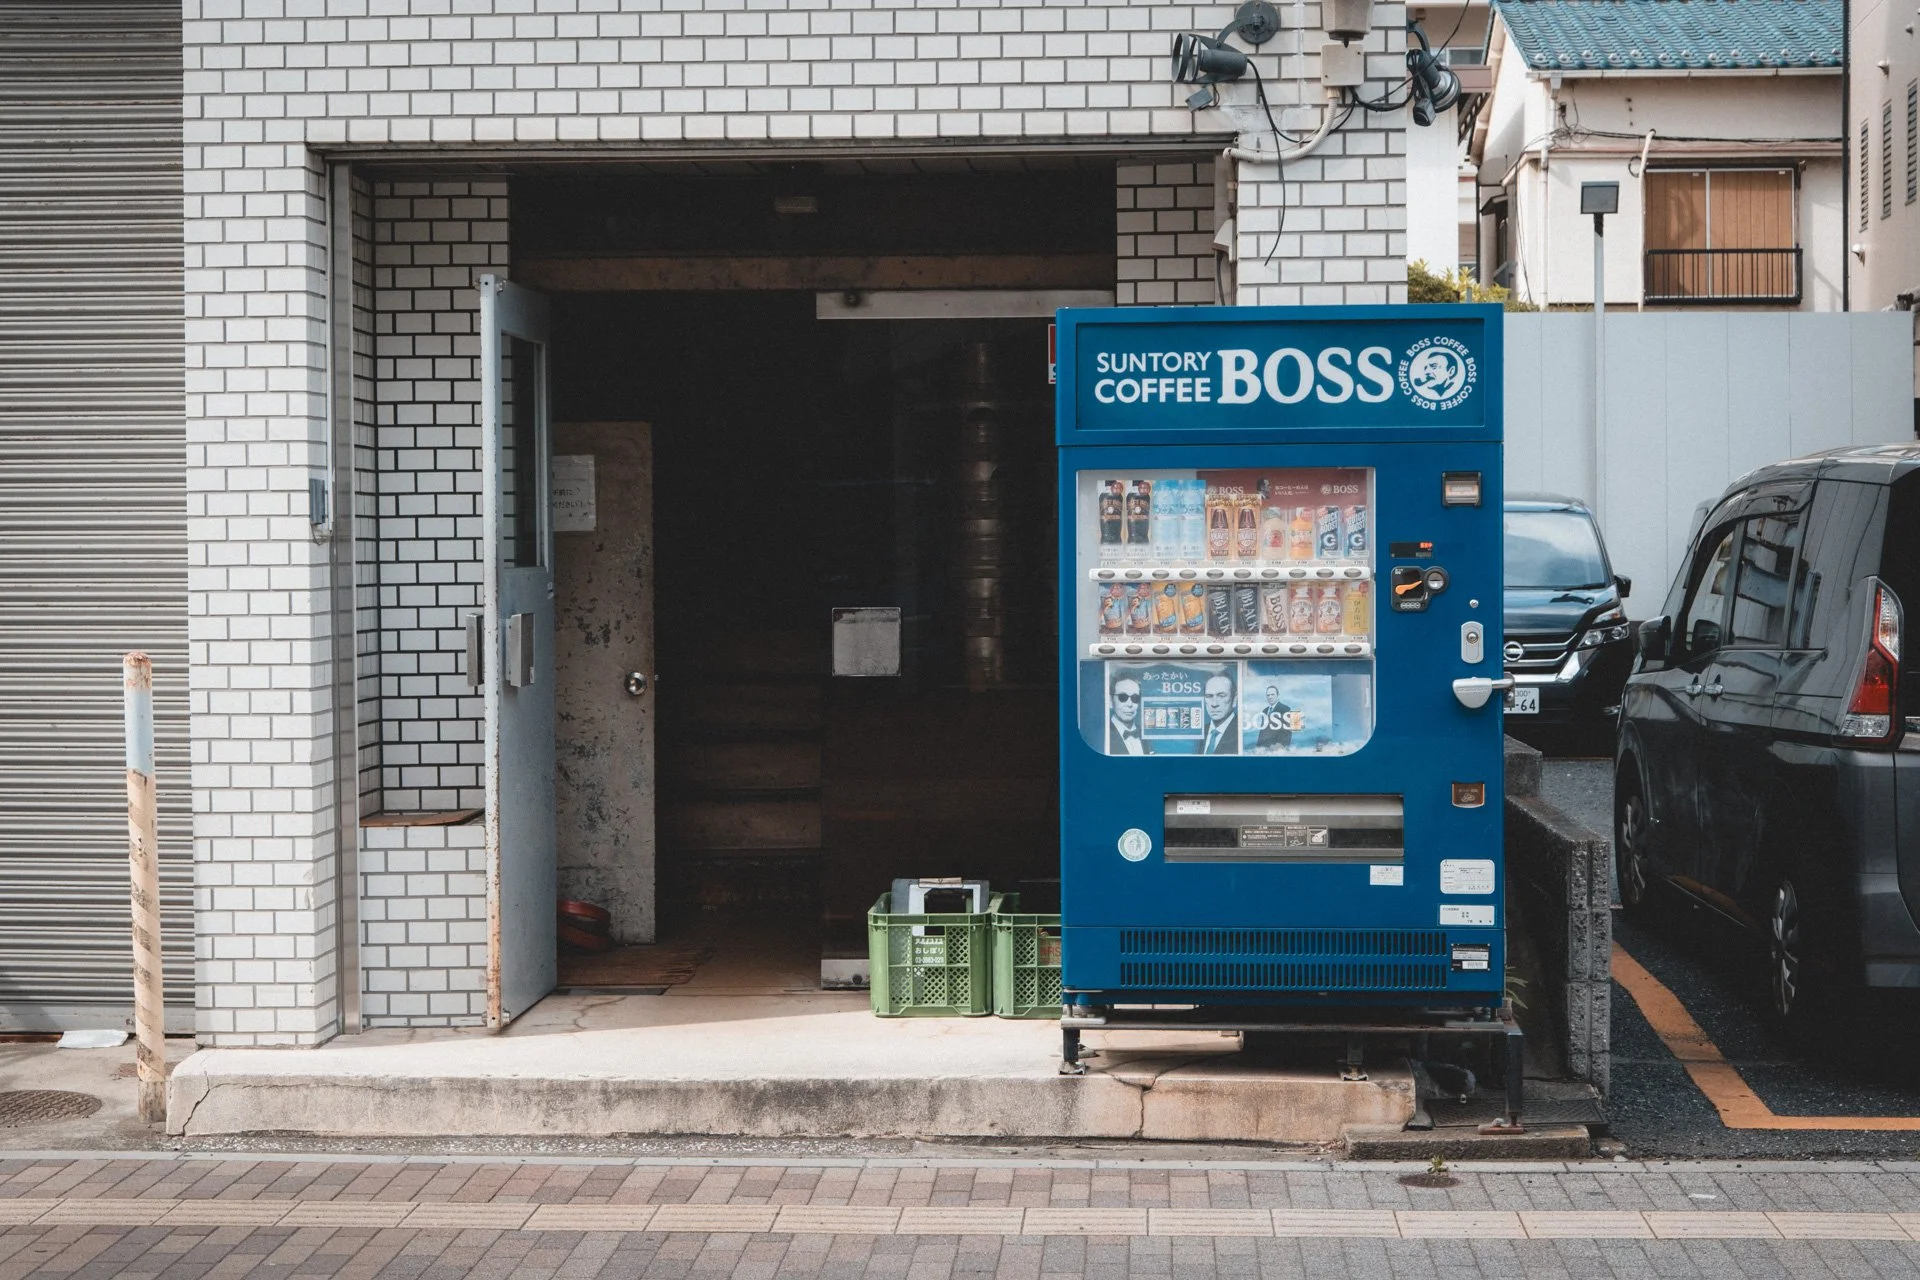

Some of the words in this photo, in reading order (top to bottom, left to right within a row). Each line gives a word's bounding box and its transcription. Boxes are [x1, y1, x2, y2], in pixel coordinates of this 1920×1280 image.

[1406, 338, 1431, 357] BOSS
[1433, 336, 1470, 357] COFFEE
[1096, 351, 1212, 373] SUNTORY
[1465, 357, 1477, 383] BOSS
[1094, 378, 1211, 404] COFFEE
[1217, 346, 1395, 405] BOSS
[1398, 359, 1413, 396] COFFEE
[1410, 395, 1437, 411] BOSS
[1440, 385, 1473, 411] COFFEE
[1219, 486, 1244, 495] BOSS
[1333, 484, 1359, 494] BOSS
[1213, 593, 1232, 634] BLACK
[1241, 590, 1258, 631] BLACK
[1270, 595, 1286, 630] BOSS
[1143, 671, 1188, 681] あったかい
[1162, 681, 1202, 694] BOSS
[915, 947, 944, 955] おしぼり
